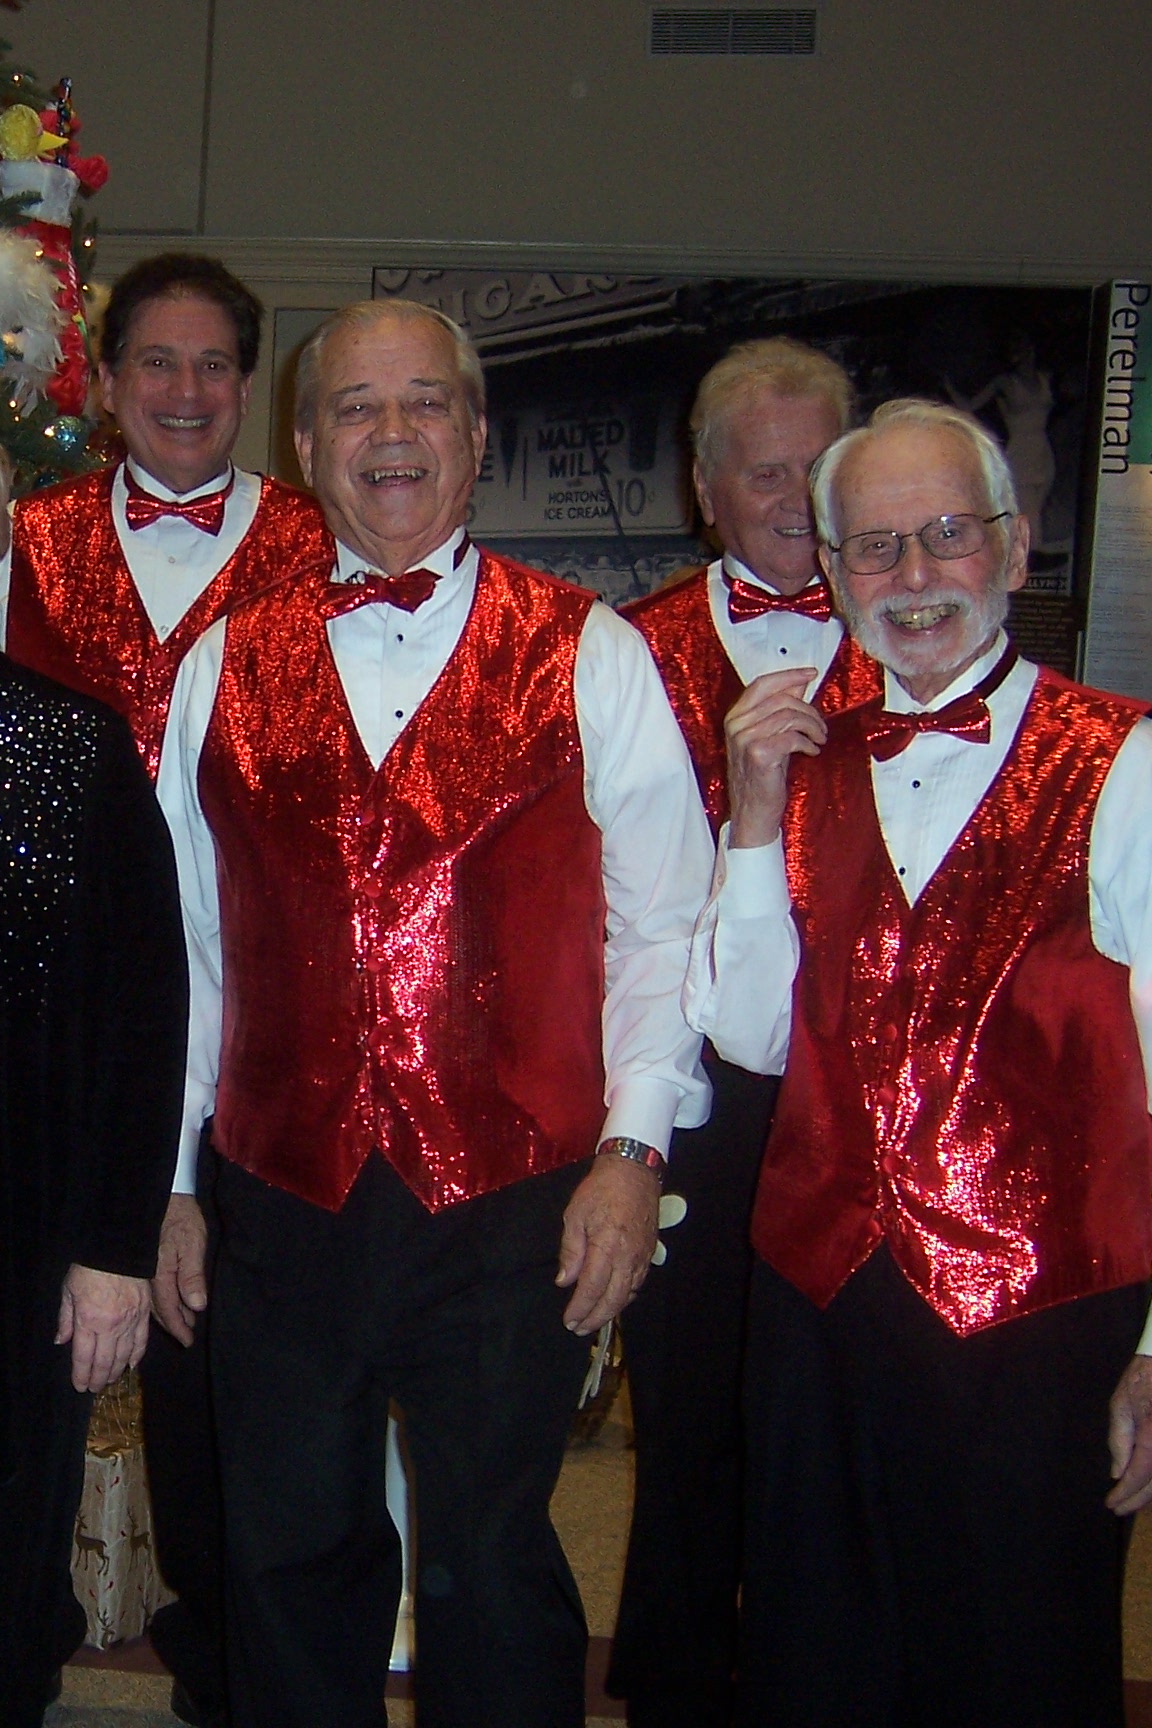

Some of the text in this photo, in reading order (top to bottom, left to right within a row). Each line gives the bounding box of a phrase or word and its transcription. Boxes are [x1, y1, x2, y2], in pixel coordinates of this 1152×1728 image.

[1101, 283, 1151, 474] Perelman
[538, 418, 625, 450] MALTED
[549, 452, 611, 478] MILK
[543, 506, 614, 520] ICE CREAM
